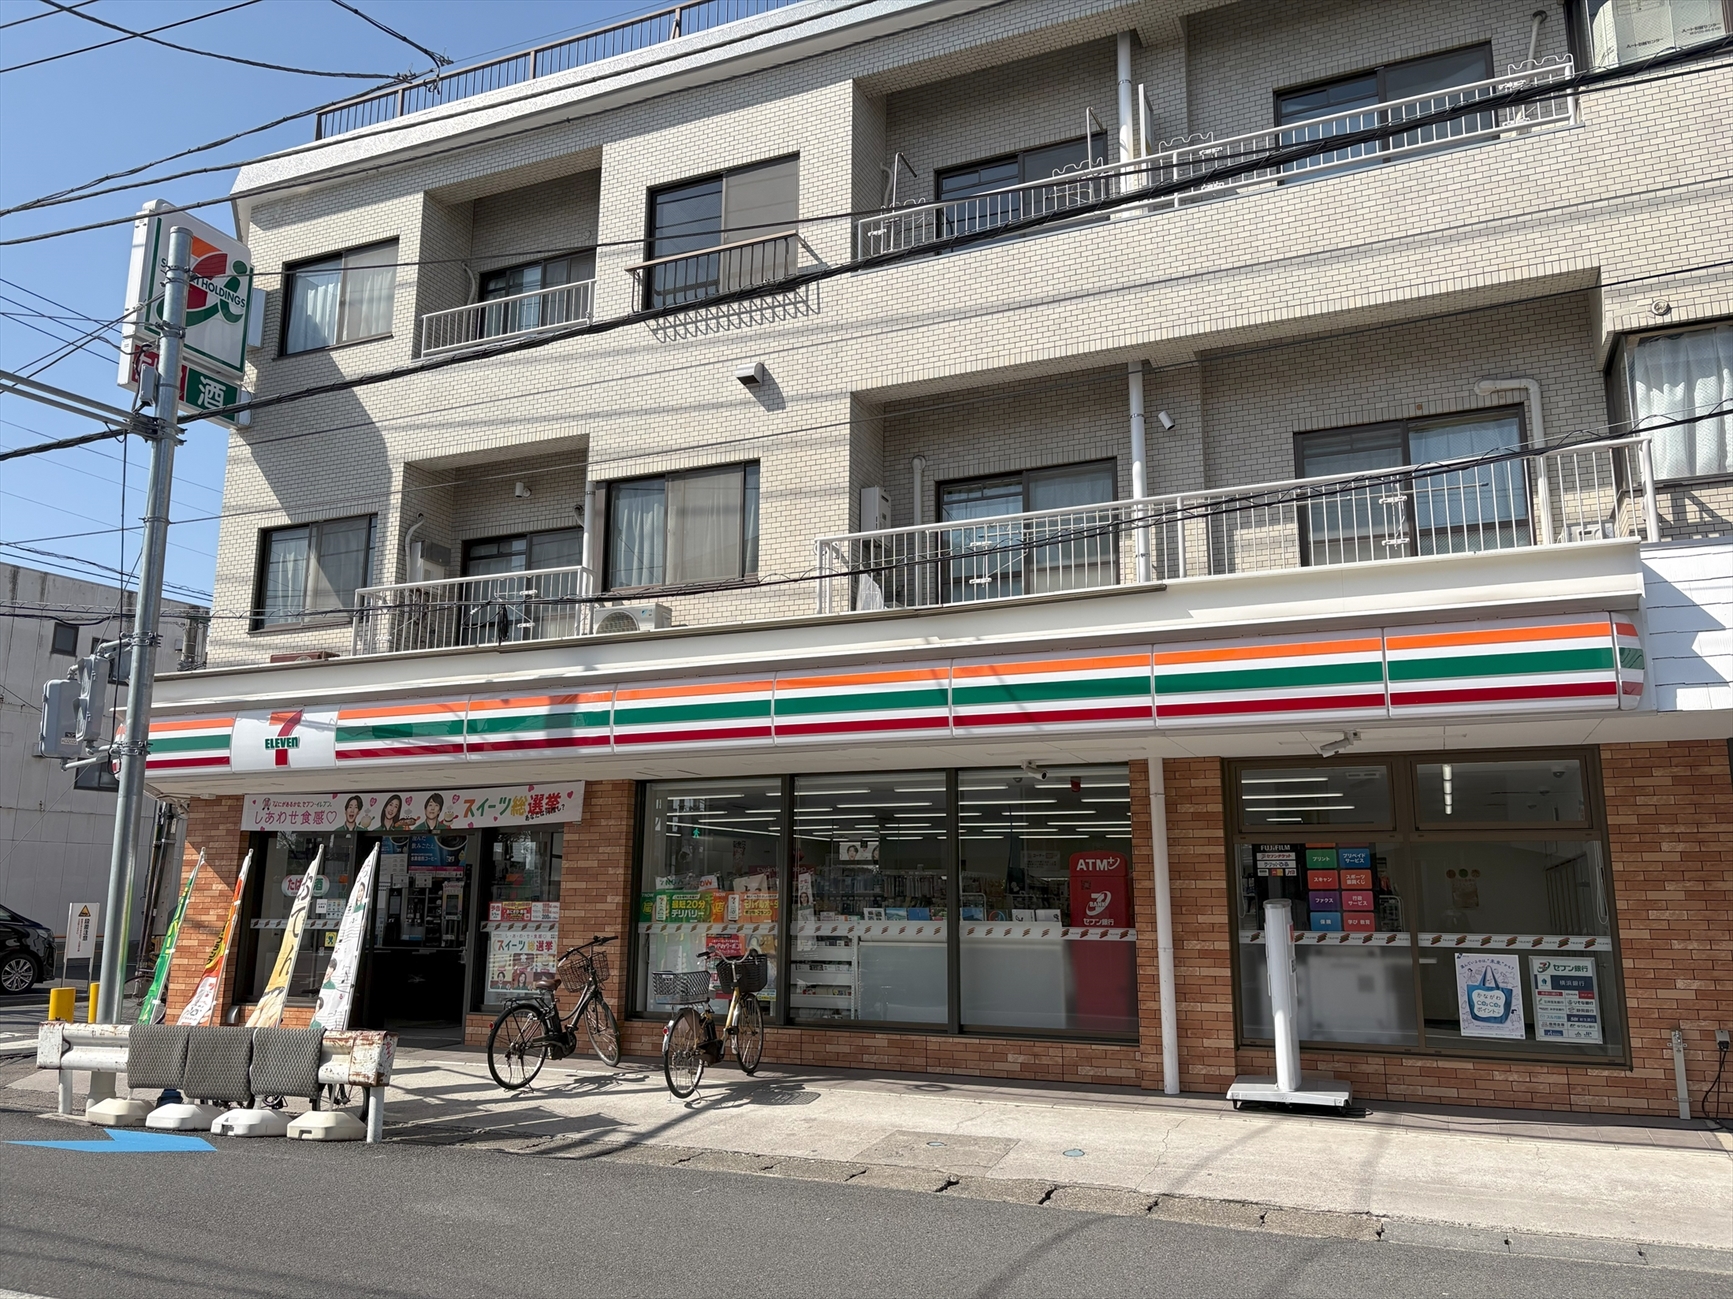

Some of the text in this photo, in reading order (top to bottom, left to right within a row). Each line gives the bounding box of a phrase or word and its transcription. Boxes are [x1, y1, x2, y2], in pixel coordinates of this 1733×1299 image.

[200, 282, 246, 308] HOLDINGS
[199, 376, 226, 410] 酒
[463, 792, 562, 818] スイーツ総選挙
[1076, 858, 1108, 870] ATM
[672, 900, 705, 909] 最短20分
[1083, 918, 1114, 926] セブン銀行
[497, 940, 553, 951] スイーツ総選挙
[1553, 964, 1588, 972] セブン銀行
[1476, 992, 1501, 1001] かながわ
